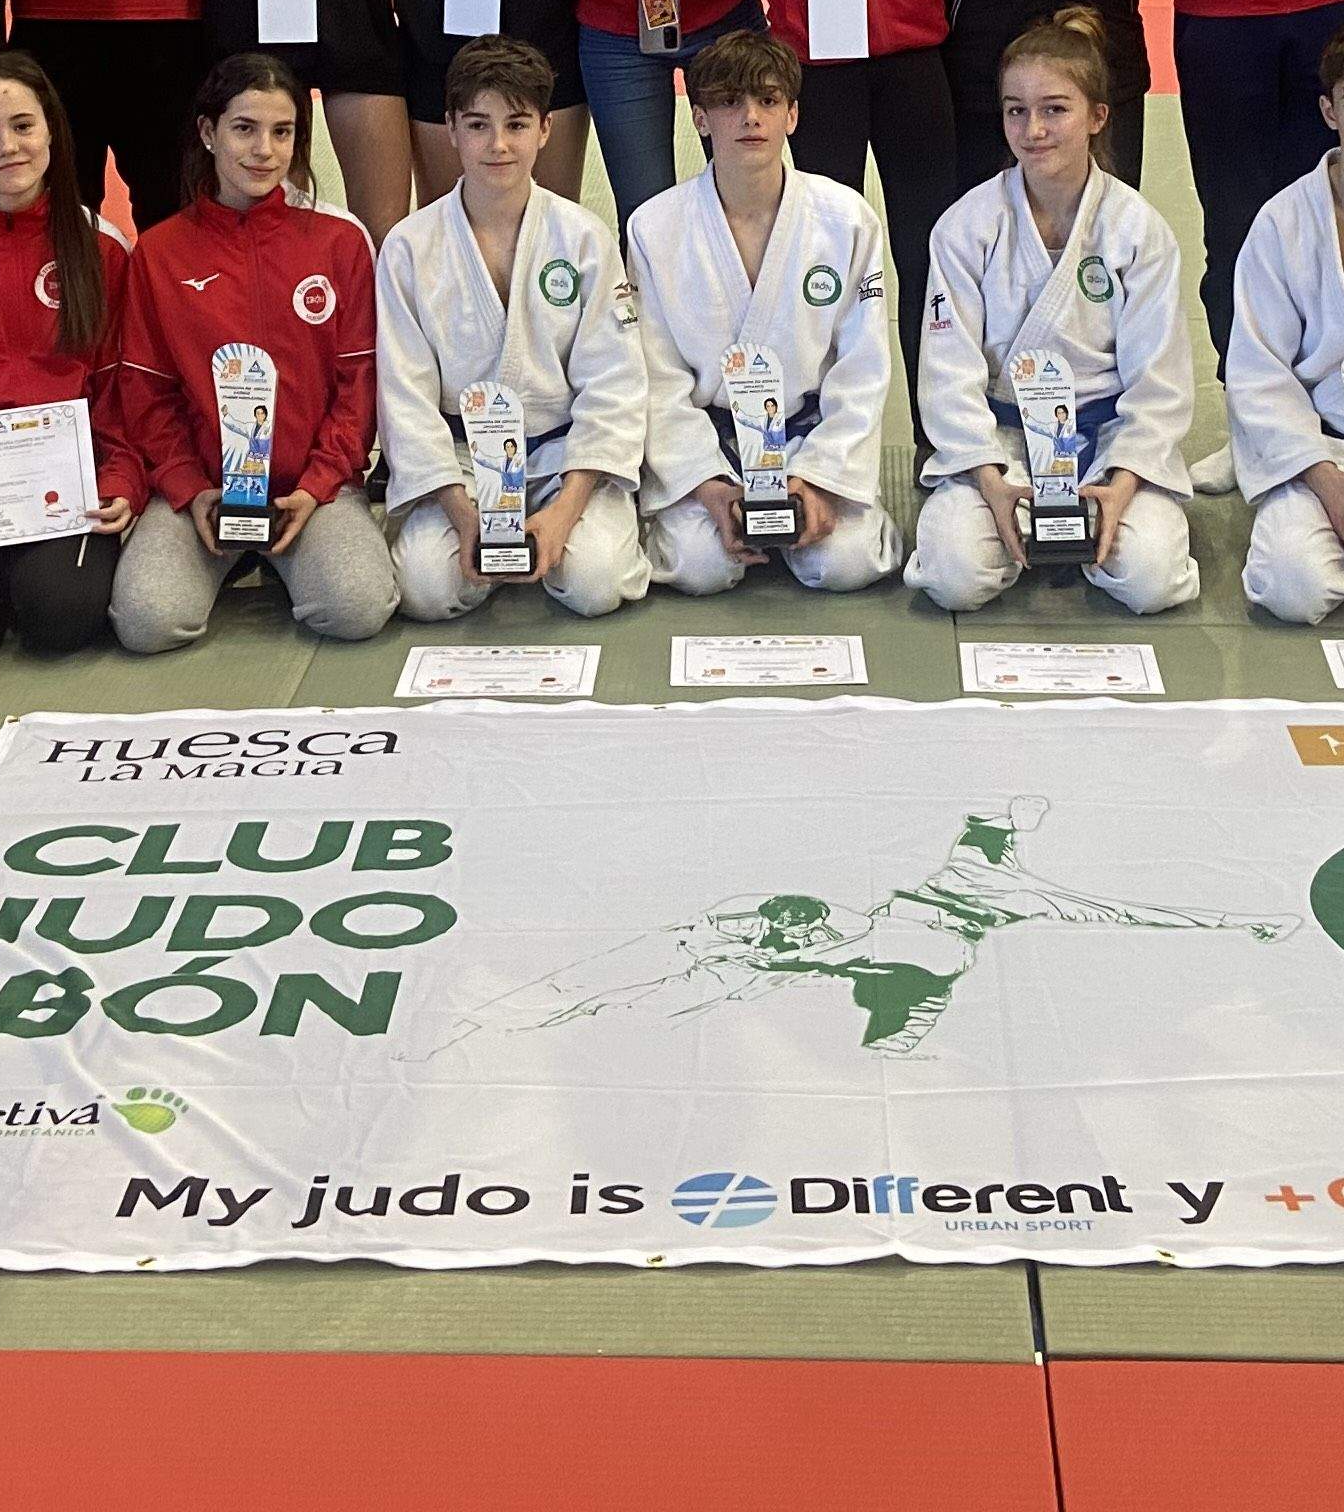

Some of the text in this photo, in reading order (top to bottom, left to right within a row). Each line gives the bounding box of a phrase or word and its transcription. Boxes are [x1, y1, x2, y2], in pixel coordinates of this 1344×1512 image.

[3, 818, 454, 876] CLUB
[115, 1175, 273, 1227] My
[291, 1173, 530, 1230] judo
[569, 1173, 644, 1217] is
[790, 1174, 1133, 1215] Different
[1165, 1181, 1225, 1225] y
[944, 1218, 1095, 1233] URBAN SPORT
